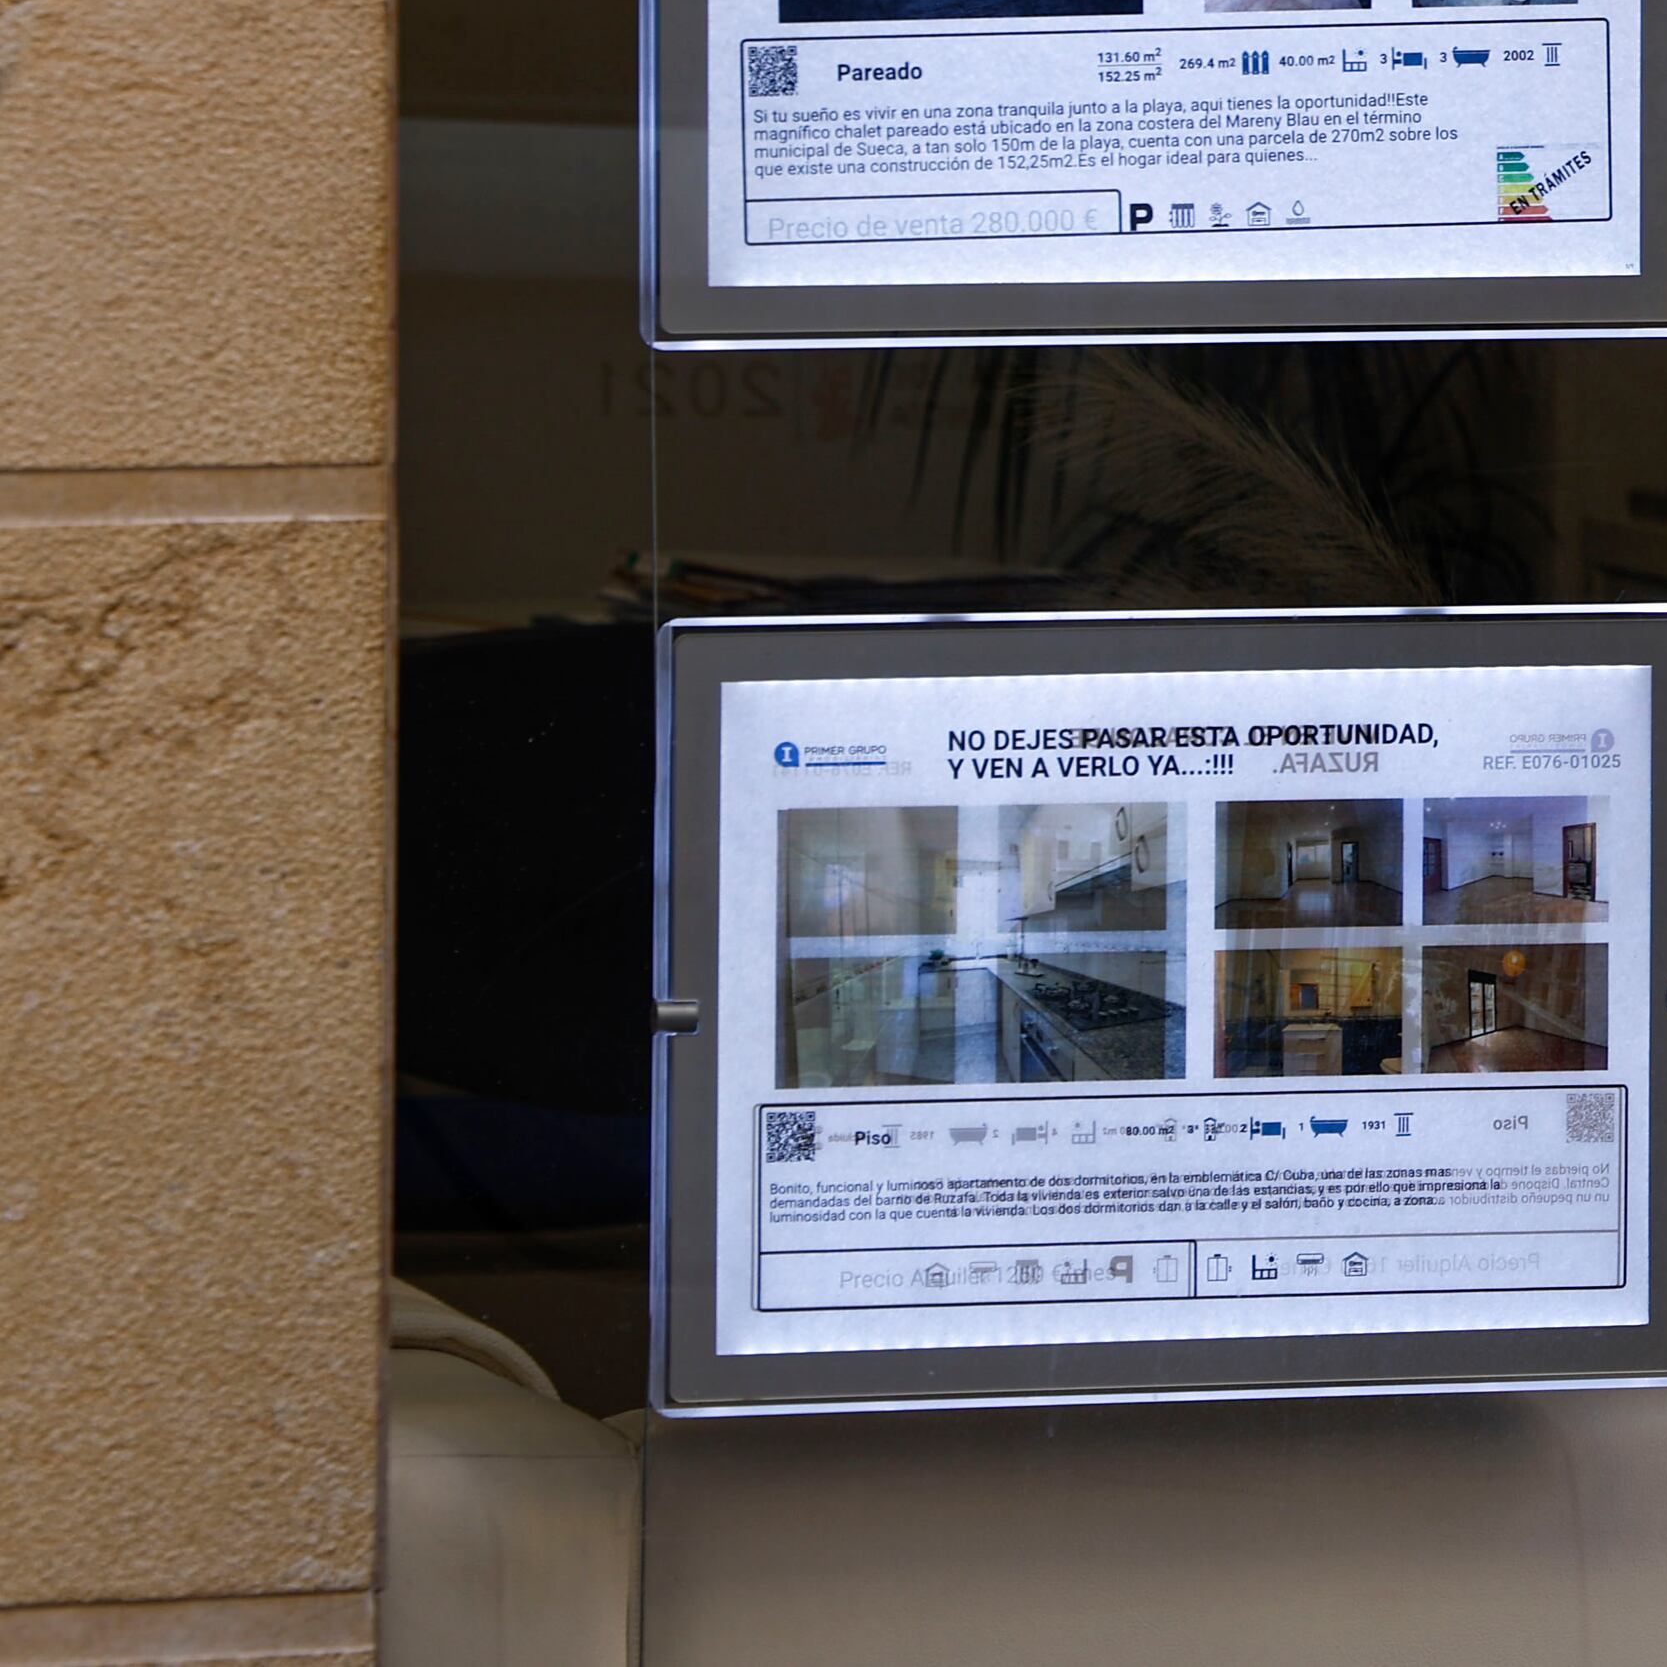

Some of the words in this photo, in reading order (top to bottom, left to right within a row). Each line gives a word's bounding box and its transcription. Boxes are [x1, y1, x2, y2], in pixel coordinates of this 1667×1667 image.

[837, 61, 923, 82] Pareado
[948, 730, 985, 751] NO
[994, 729, 1072, 751] DEJES
[1082, 727, 1167, 749] PASAR
[1175, 726, 1240, 747] ESTA
[1249, 723, 1439, 748] OPORTUNIDAD,
[947, 758, 964, 780] Y
[971, 757, 1023, 780] VEN
[1031, 757, 1050, 778] A
[1056, 755, 1140, 778] VERLO
[1483, 755, 1518, 770] REF.
[1522, 753, 1622, 770] E076-01025
